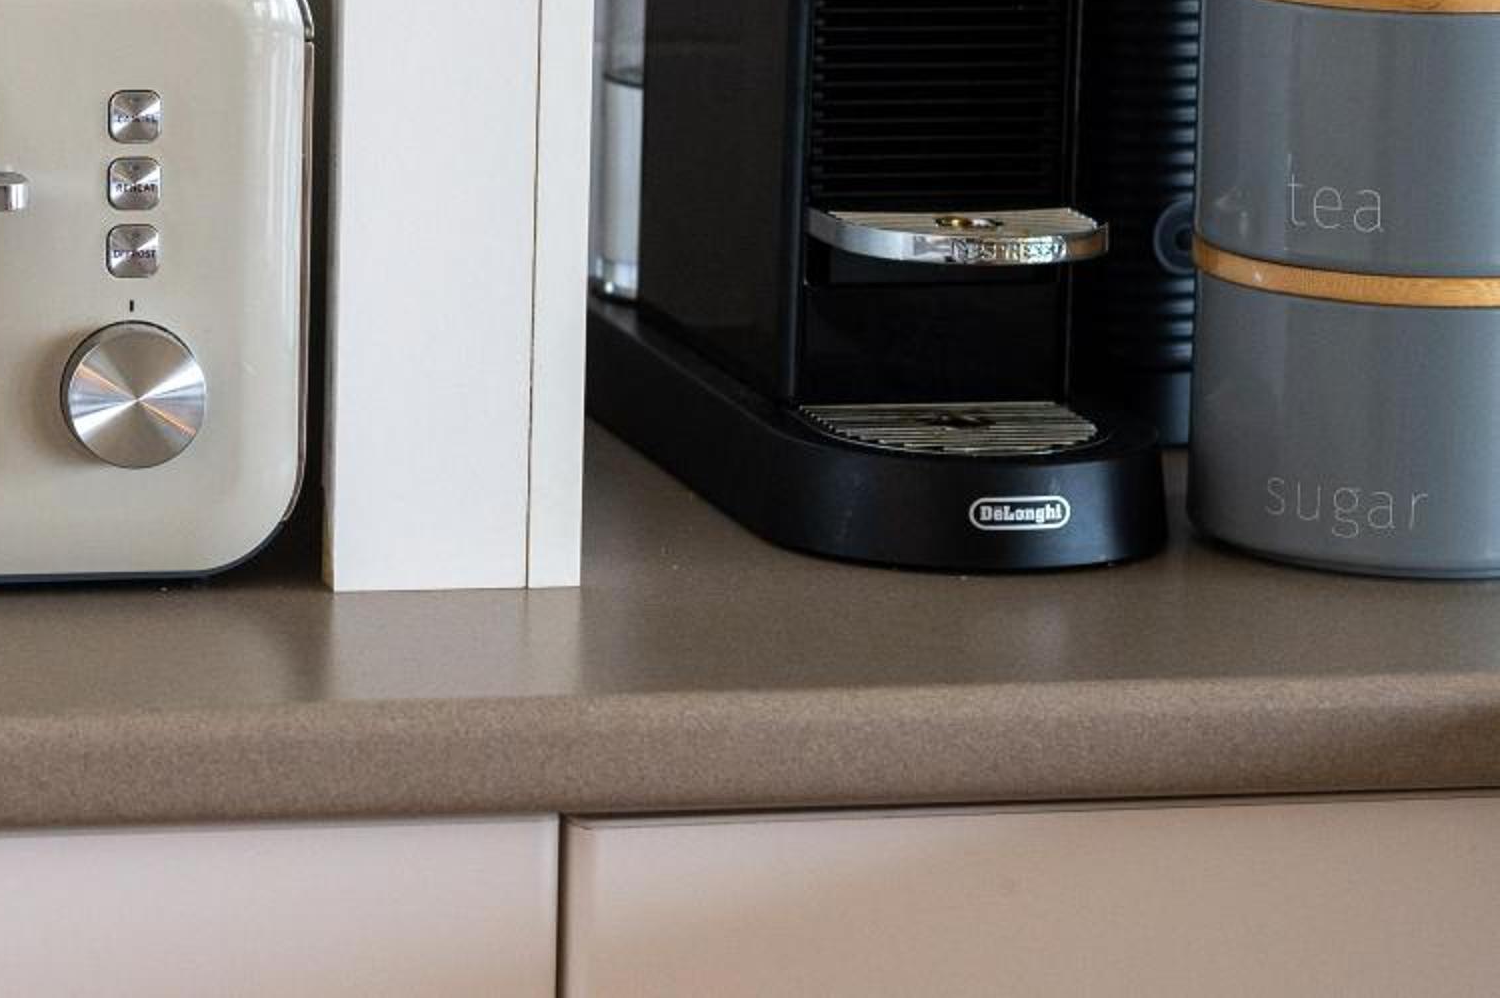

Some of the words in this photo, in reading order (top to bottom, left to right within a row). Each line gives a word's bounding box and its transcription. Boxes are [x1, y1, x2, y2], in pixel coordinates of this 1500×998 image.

[1287, 173, 1385, 233] tea
[979, 503, 1063, 523] DeLonghi
[1265, 477, 1429, 539] sugar
